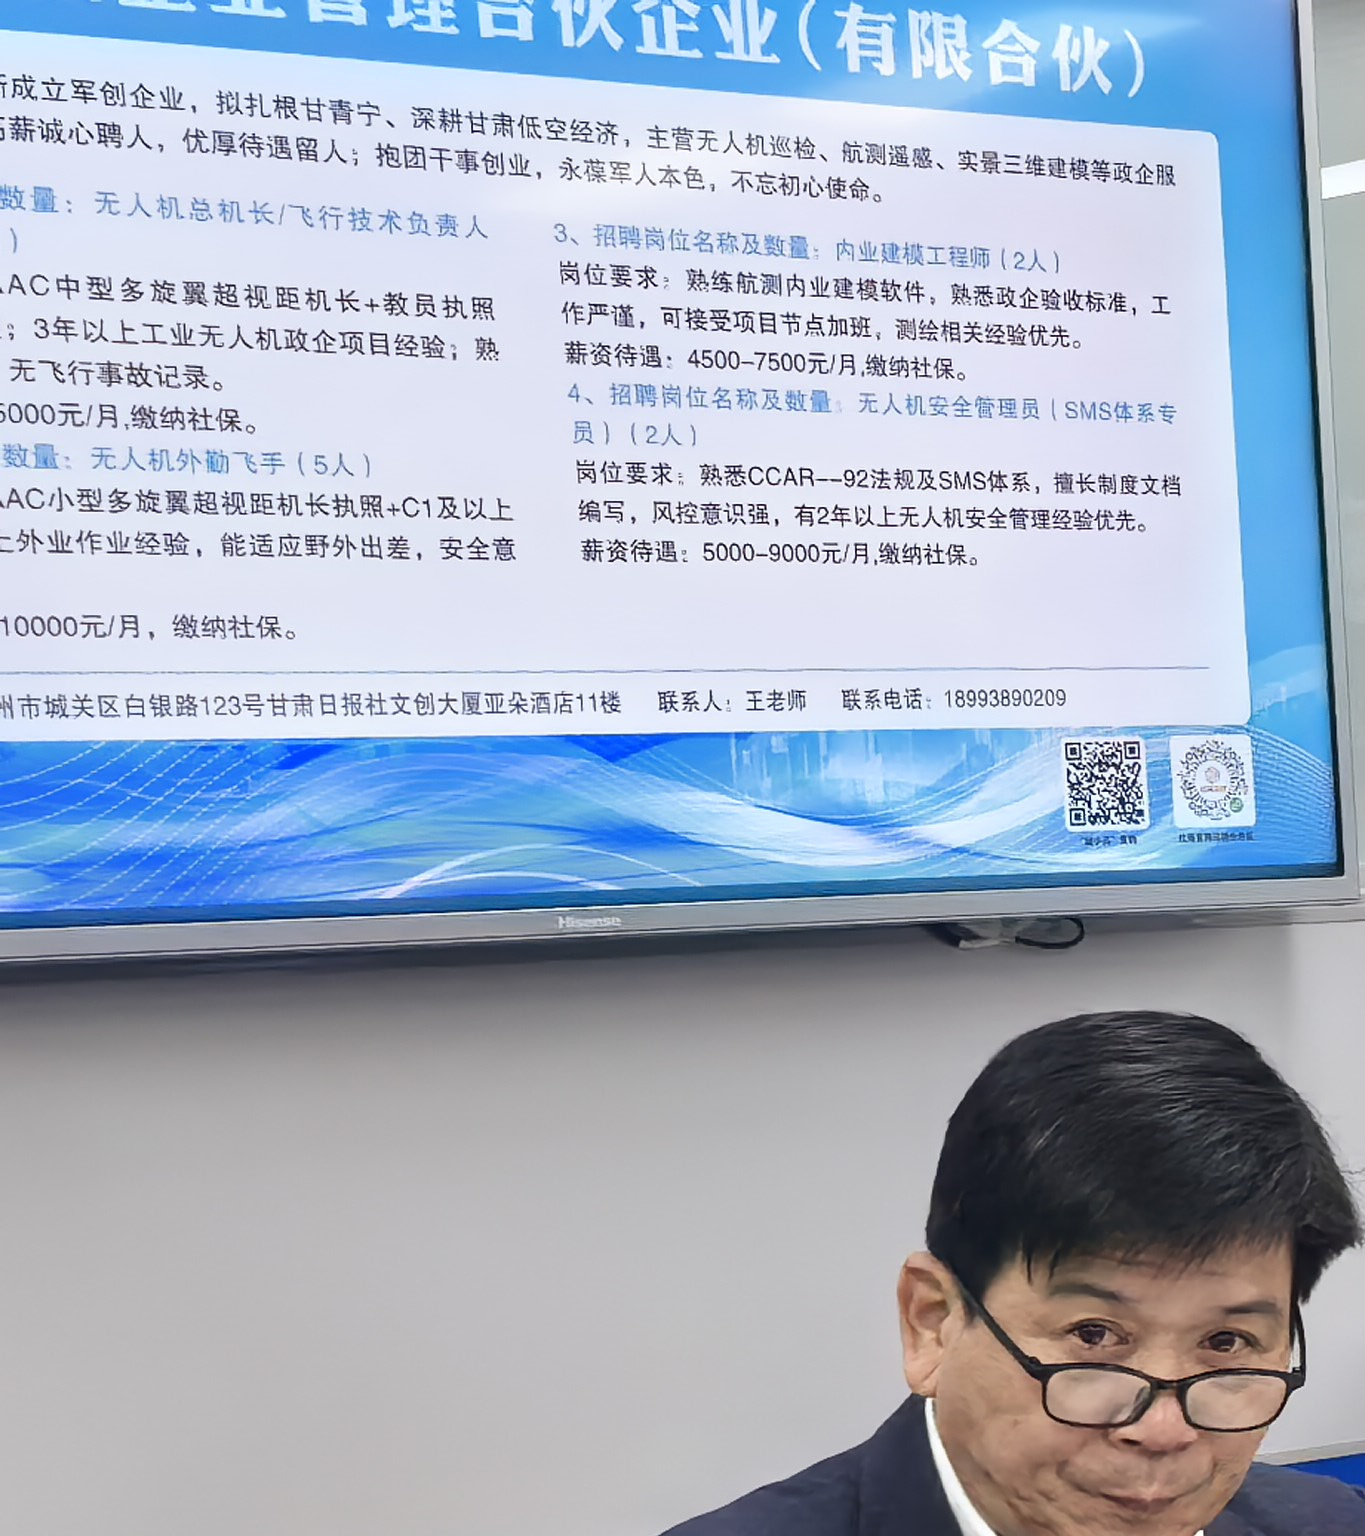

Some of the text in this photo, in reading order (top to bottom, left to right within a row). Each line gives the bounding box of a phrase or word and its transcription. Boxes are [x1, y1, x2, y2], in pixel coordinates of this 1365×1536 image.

[0, 274, 496, 322] AC中型多旋翼超视距机长+教员执照
[573, 421, 697, 446] 员）（2人）
[0, 487, 515, 524] AC小型多旋翼超视距机长执照+C1及以上
[657, 689, 807, 715] 联系人：王老师
